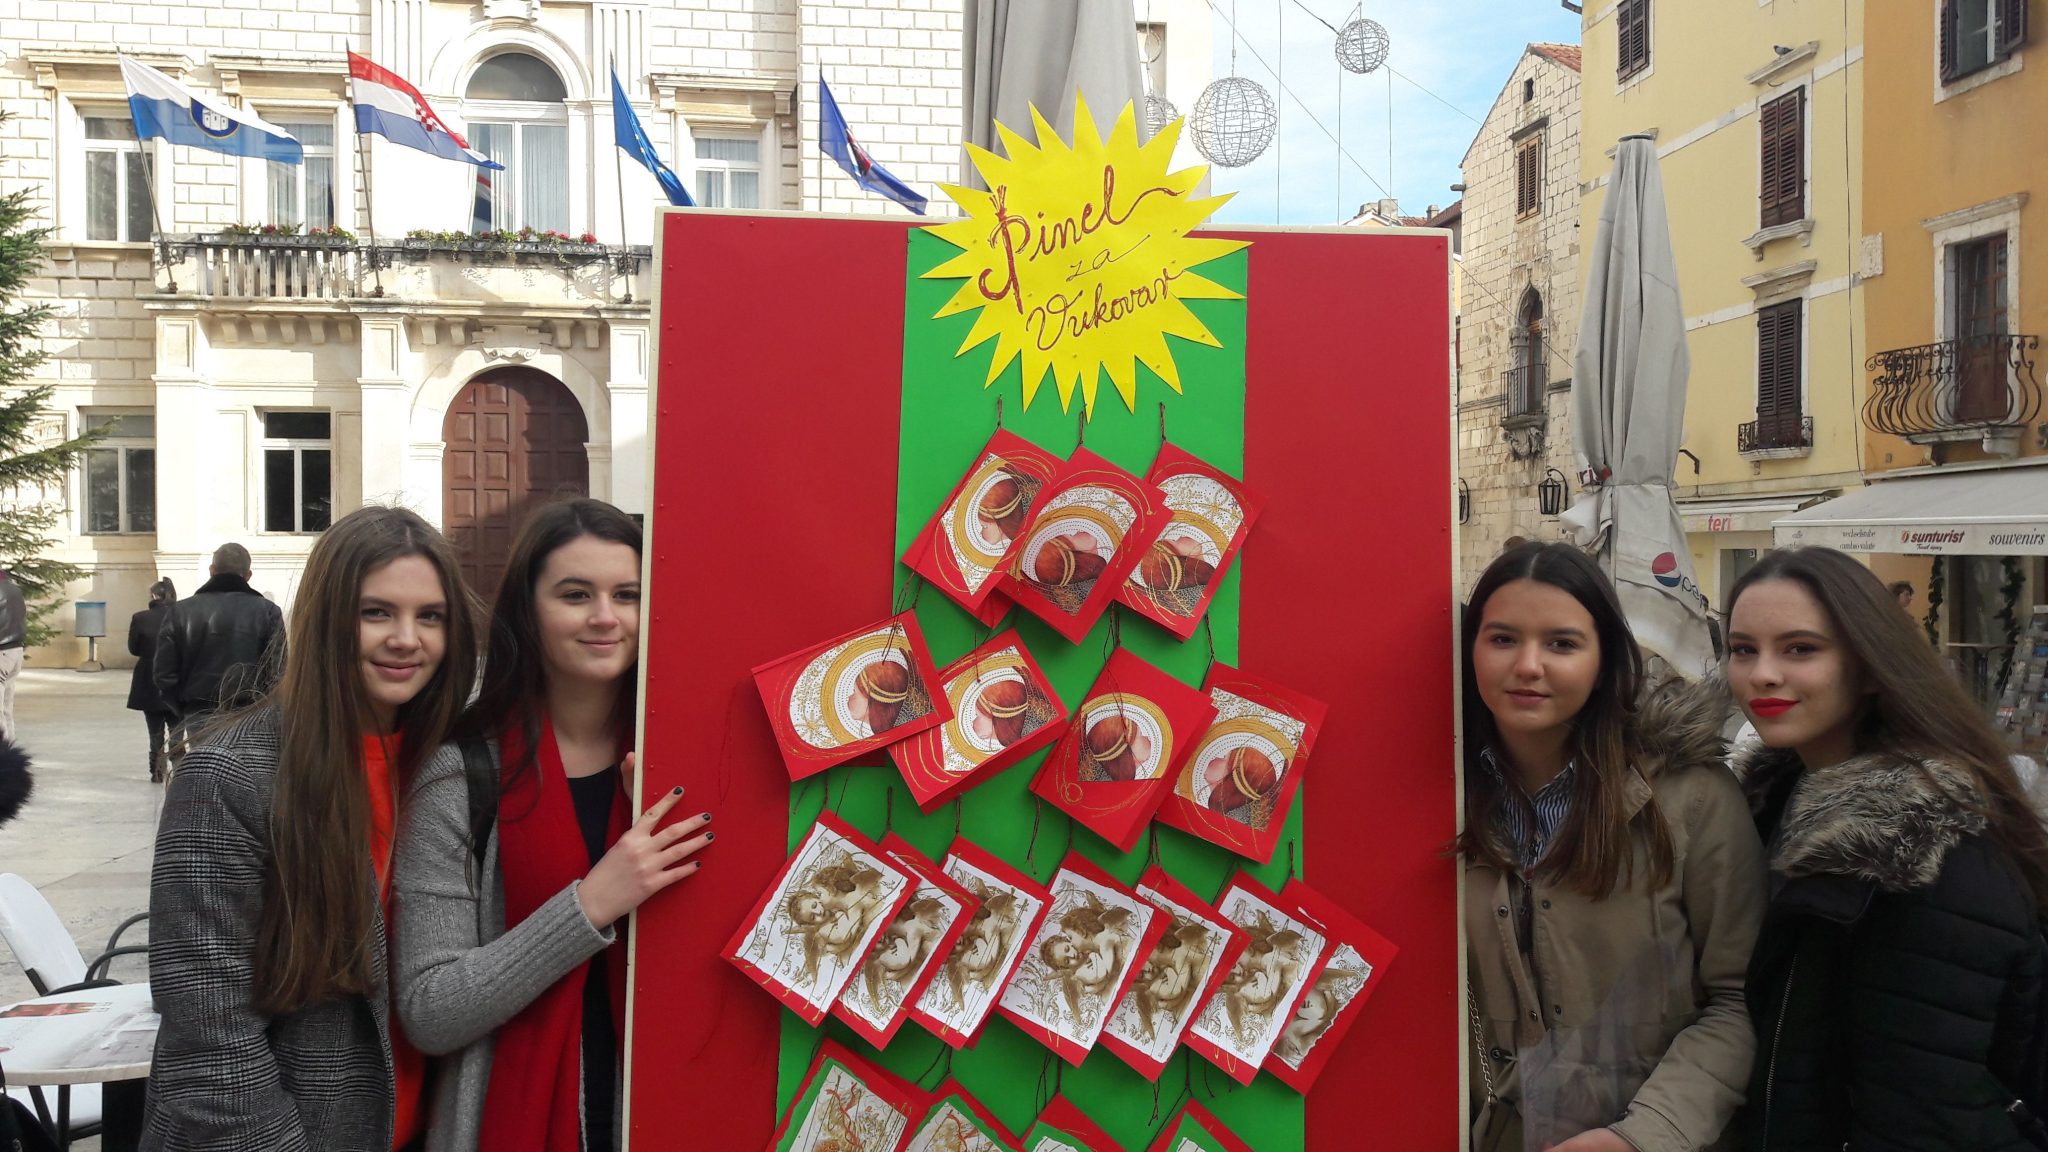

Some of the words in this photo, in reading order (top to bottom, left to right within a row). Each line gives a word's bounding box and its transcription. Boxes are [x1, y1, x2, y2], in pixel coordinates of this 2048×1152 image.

[978, 165, 1185, 315] Pinel
[1066, 234, 1150, 282] za
[1026, 268, 1185, 350] Vukovar
[1910, 529, 1965, 543] sunturist
[1988, 528, 2046, 546] souvenirs
